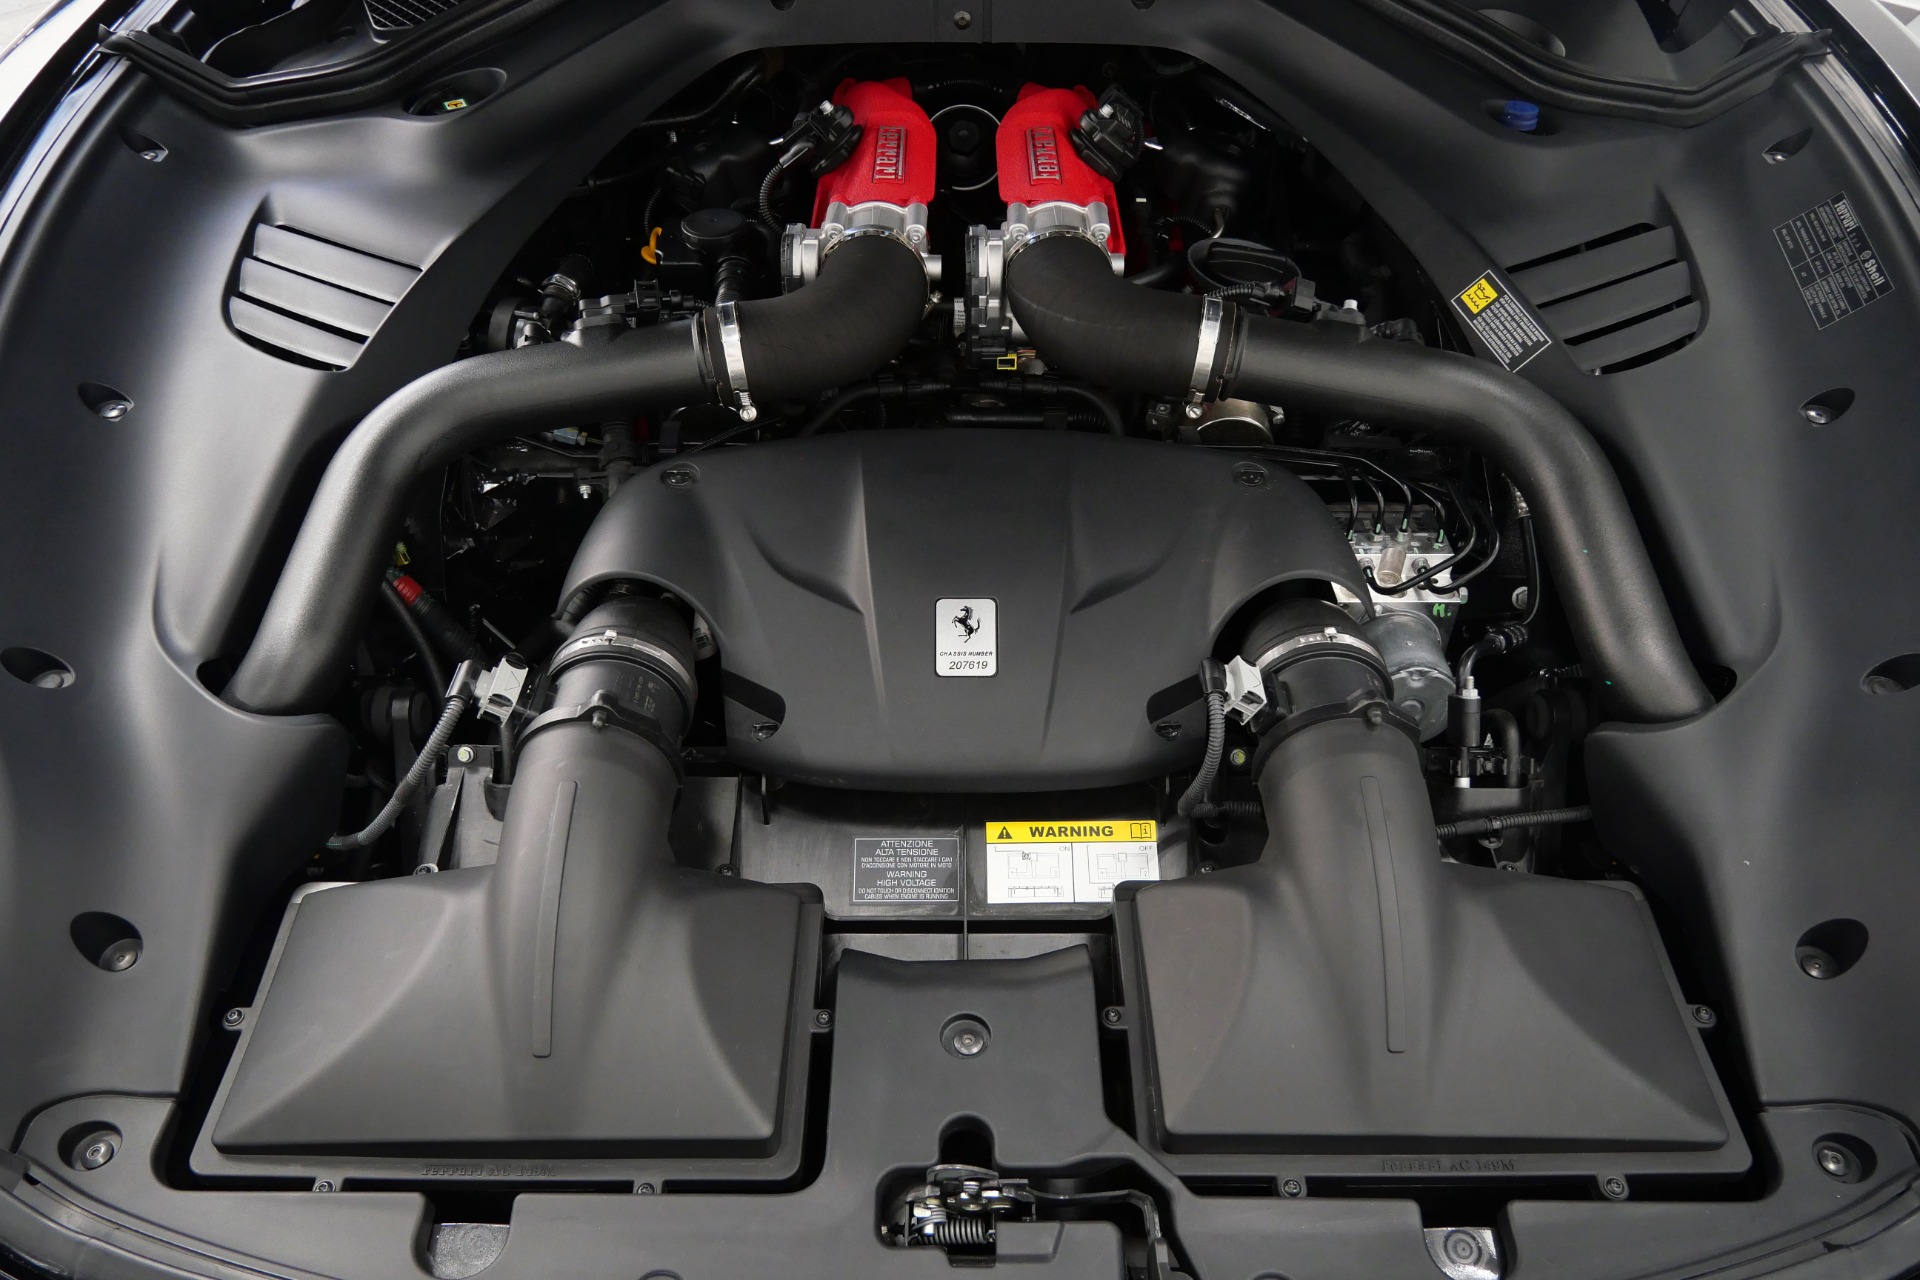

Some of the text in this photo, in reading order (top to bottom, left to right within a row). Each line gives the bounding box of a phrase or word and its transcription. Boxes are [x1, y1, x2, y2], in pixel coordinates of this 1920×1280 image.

[1834, 199, 1858, 232] Ferrari
[1864, 259, 1886, 286] Shell
[949, 661, 988, 669] 207619
[1029, 826, 1114, 837] WARNING
